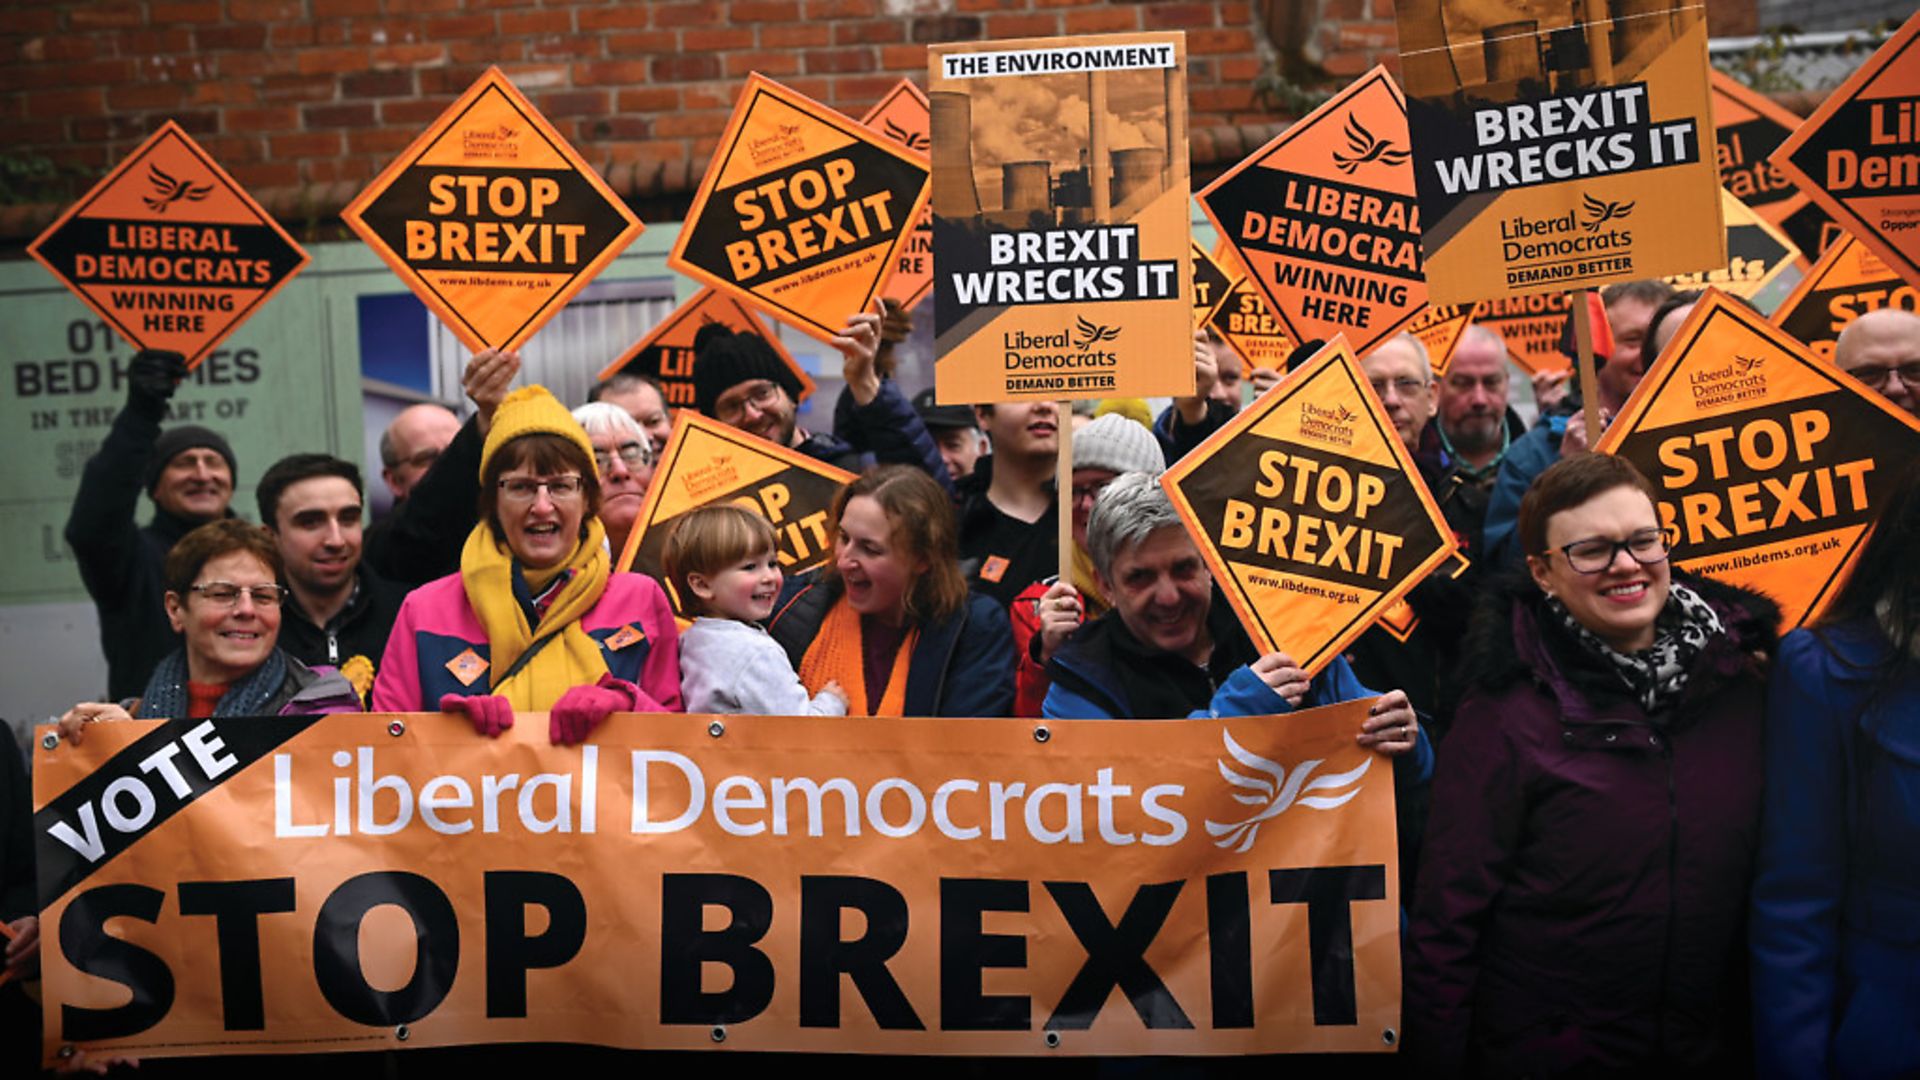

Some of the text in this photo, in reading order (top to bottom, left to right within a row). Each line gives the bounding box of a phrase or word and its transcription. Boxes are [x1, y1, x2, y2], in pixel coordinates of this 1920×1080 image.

[946, 47, 1170, 76] THE ENVIRONMENT
[1475, 86, 1643, 147] BREXIT
[1435, 133, 1635, 194] WRECKS
[1650, 123, 1692, 164] IT
[429, 174, 560, 218] STOP
[733, 158, 855, 231] STOP
[1285, 181, 1421, 234] LIBERAL
[108, 225, 239, 252] LIBERAL
[405, 220, 585, 264] BREXIT
[725, 190, 894, 281] BREXIT
[1242, 211, 1424, 272] DEMOCRA
[1501, 210, 1575, 240] Liberal
[899, 258, 924, 273] RE
[990, 228, 1135, 265] BREXIT
[1504, 230, 1632, 263] Democrats
[76, 255, 271, 283] DEMOCRATS
[438, 276, 551, 290] www.libdems.org.uk
[953, 266, 1125, 304] WRECKS
[1137, 265, 1174, 297] IT
[1274, 262, 1408, 307] WINNING
[1508, 257, 1632, 284] DEMAND BETTER
[111, 291, 234, 312] WINNING
[1302, 295, 1371, 329] HERE
[144, 315, 205, 332] HERE
[1004, 329, 1070, 350] Liberal
[15, 349, 261, 397] BED HES
[1005, 350, 1116, 370] Democrats
[1690, 365, 1732, 384] Liberal
[1006, 375, 1116, 390] DEMAND BETTER
[31, 411, 58, 430] IN
[215, 398, 249, 419] OF
[1658, 410, 1830, 489] STOP
[1255, 450, 1386, 520] STOP
[1658, 458, 1875, 547] BREXIT
[1220, 499, 1403, 580] BREXIT
[1248, 575, 1360, 604] www.libdems.org.uk
[48, 719, 239, 864] VOTE
[274, 746, 1187, 845] Liberal Democrats
[58, 864, 1386, 1042] STOP BREXIT
